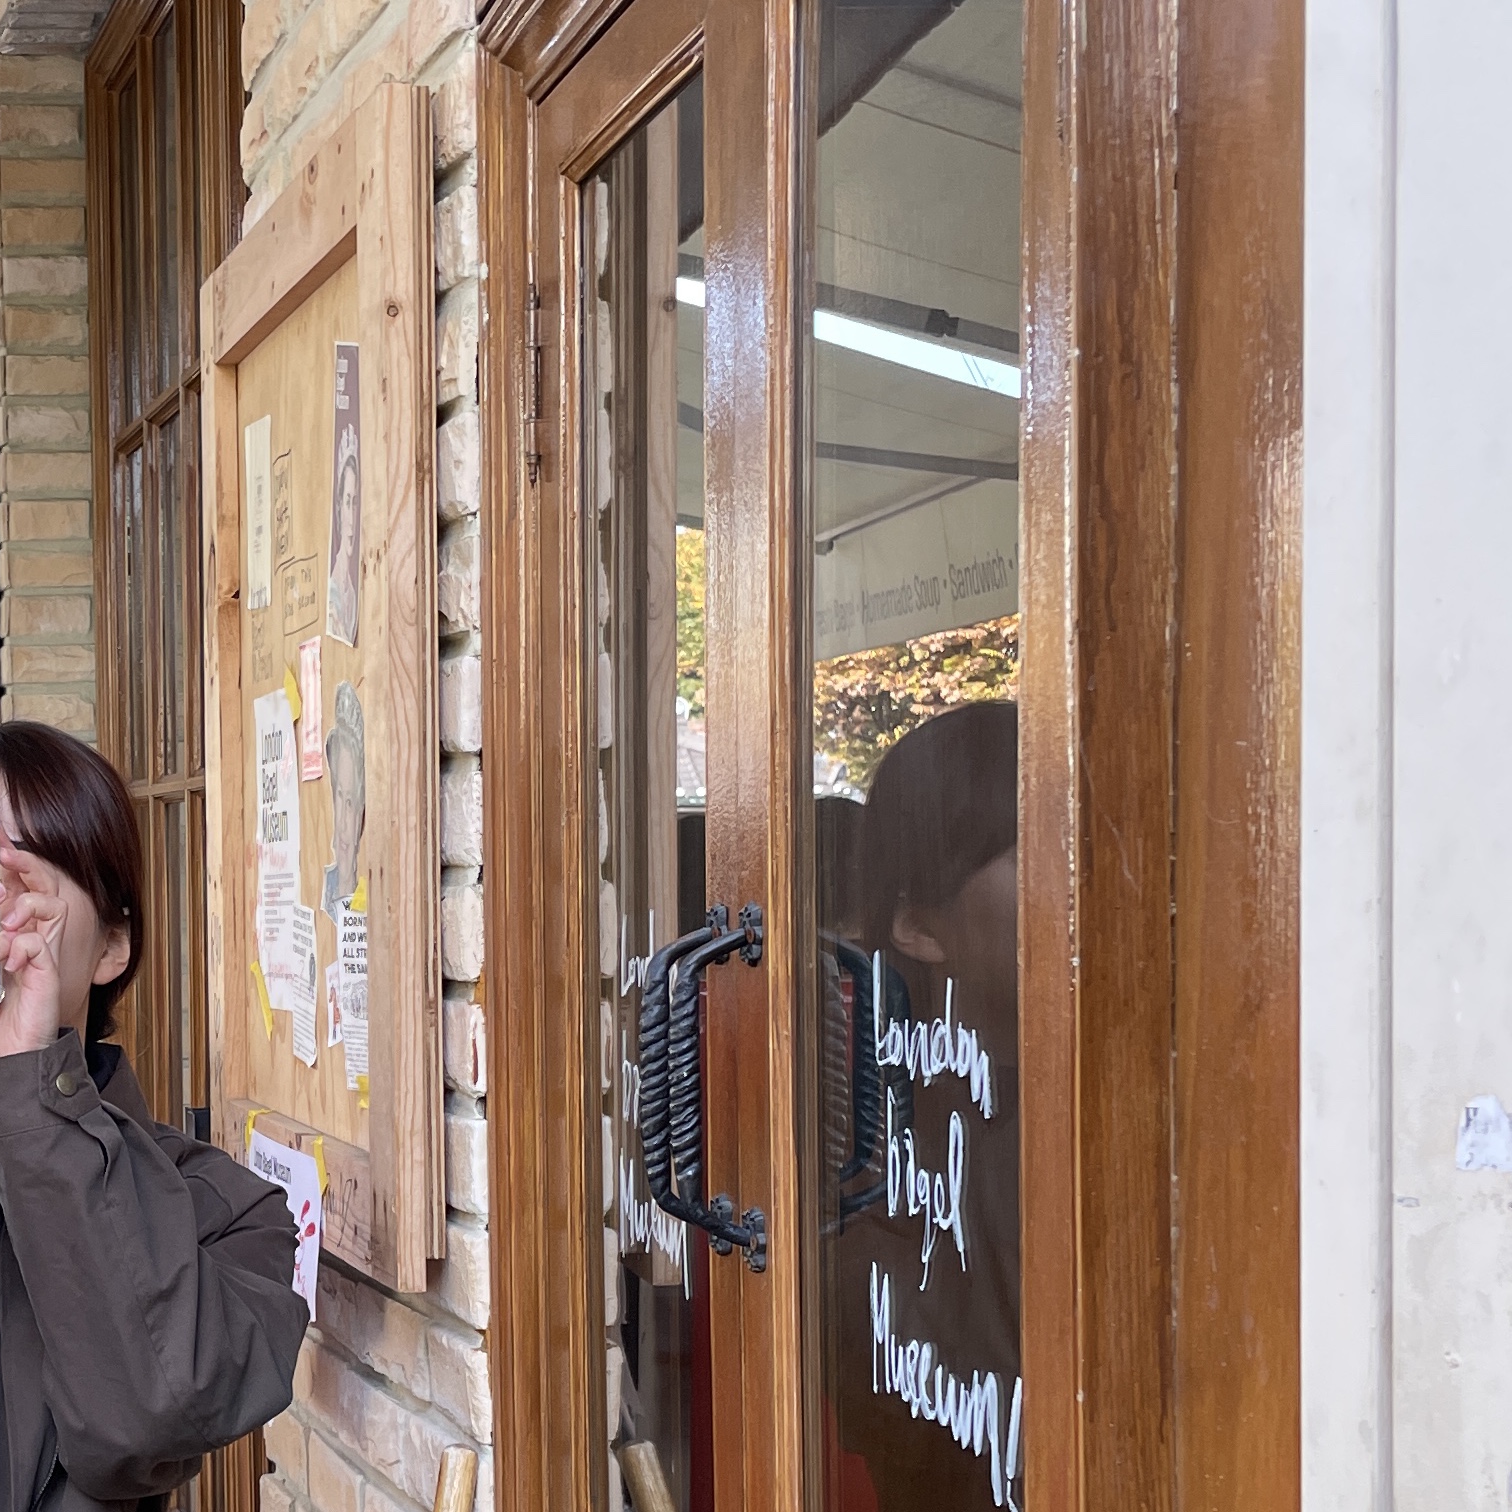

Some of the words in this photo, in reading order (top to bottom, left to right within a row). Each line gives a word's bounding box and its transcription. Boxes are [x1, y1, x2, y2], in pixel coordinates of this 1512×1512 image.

[913, 575, 941, 615] Soup
[948, 548, 1008, 601] Sandwich
[873, 949, 993, 1119] London
